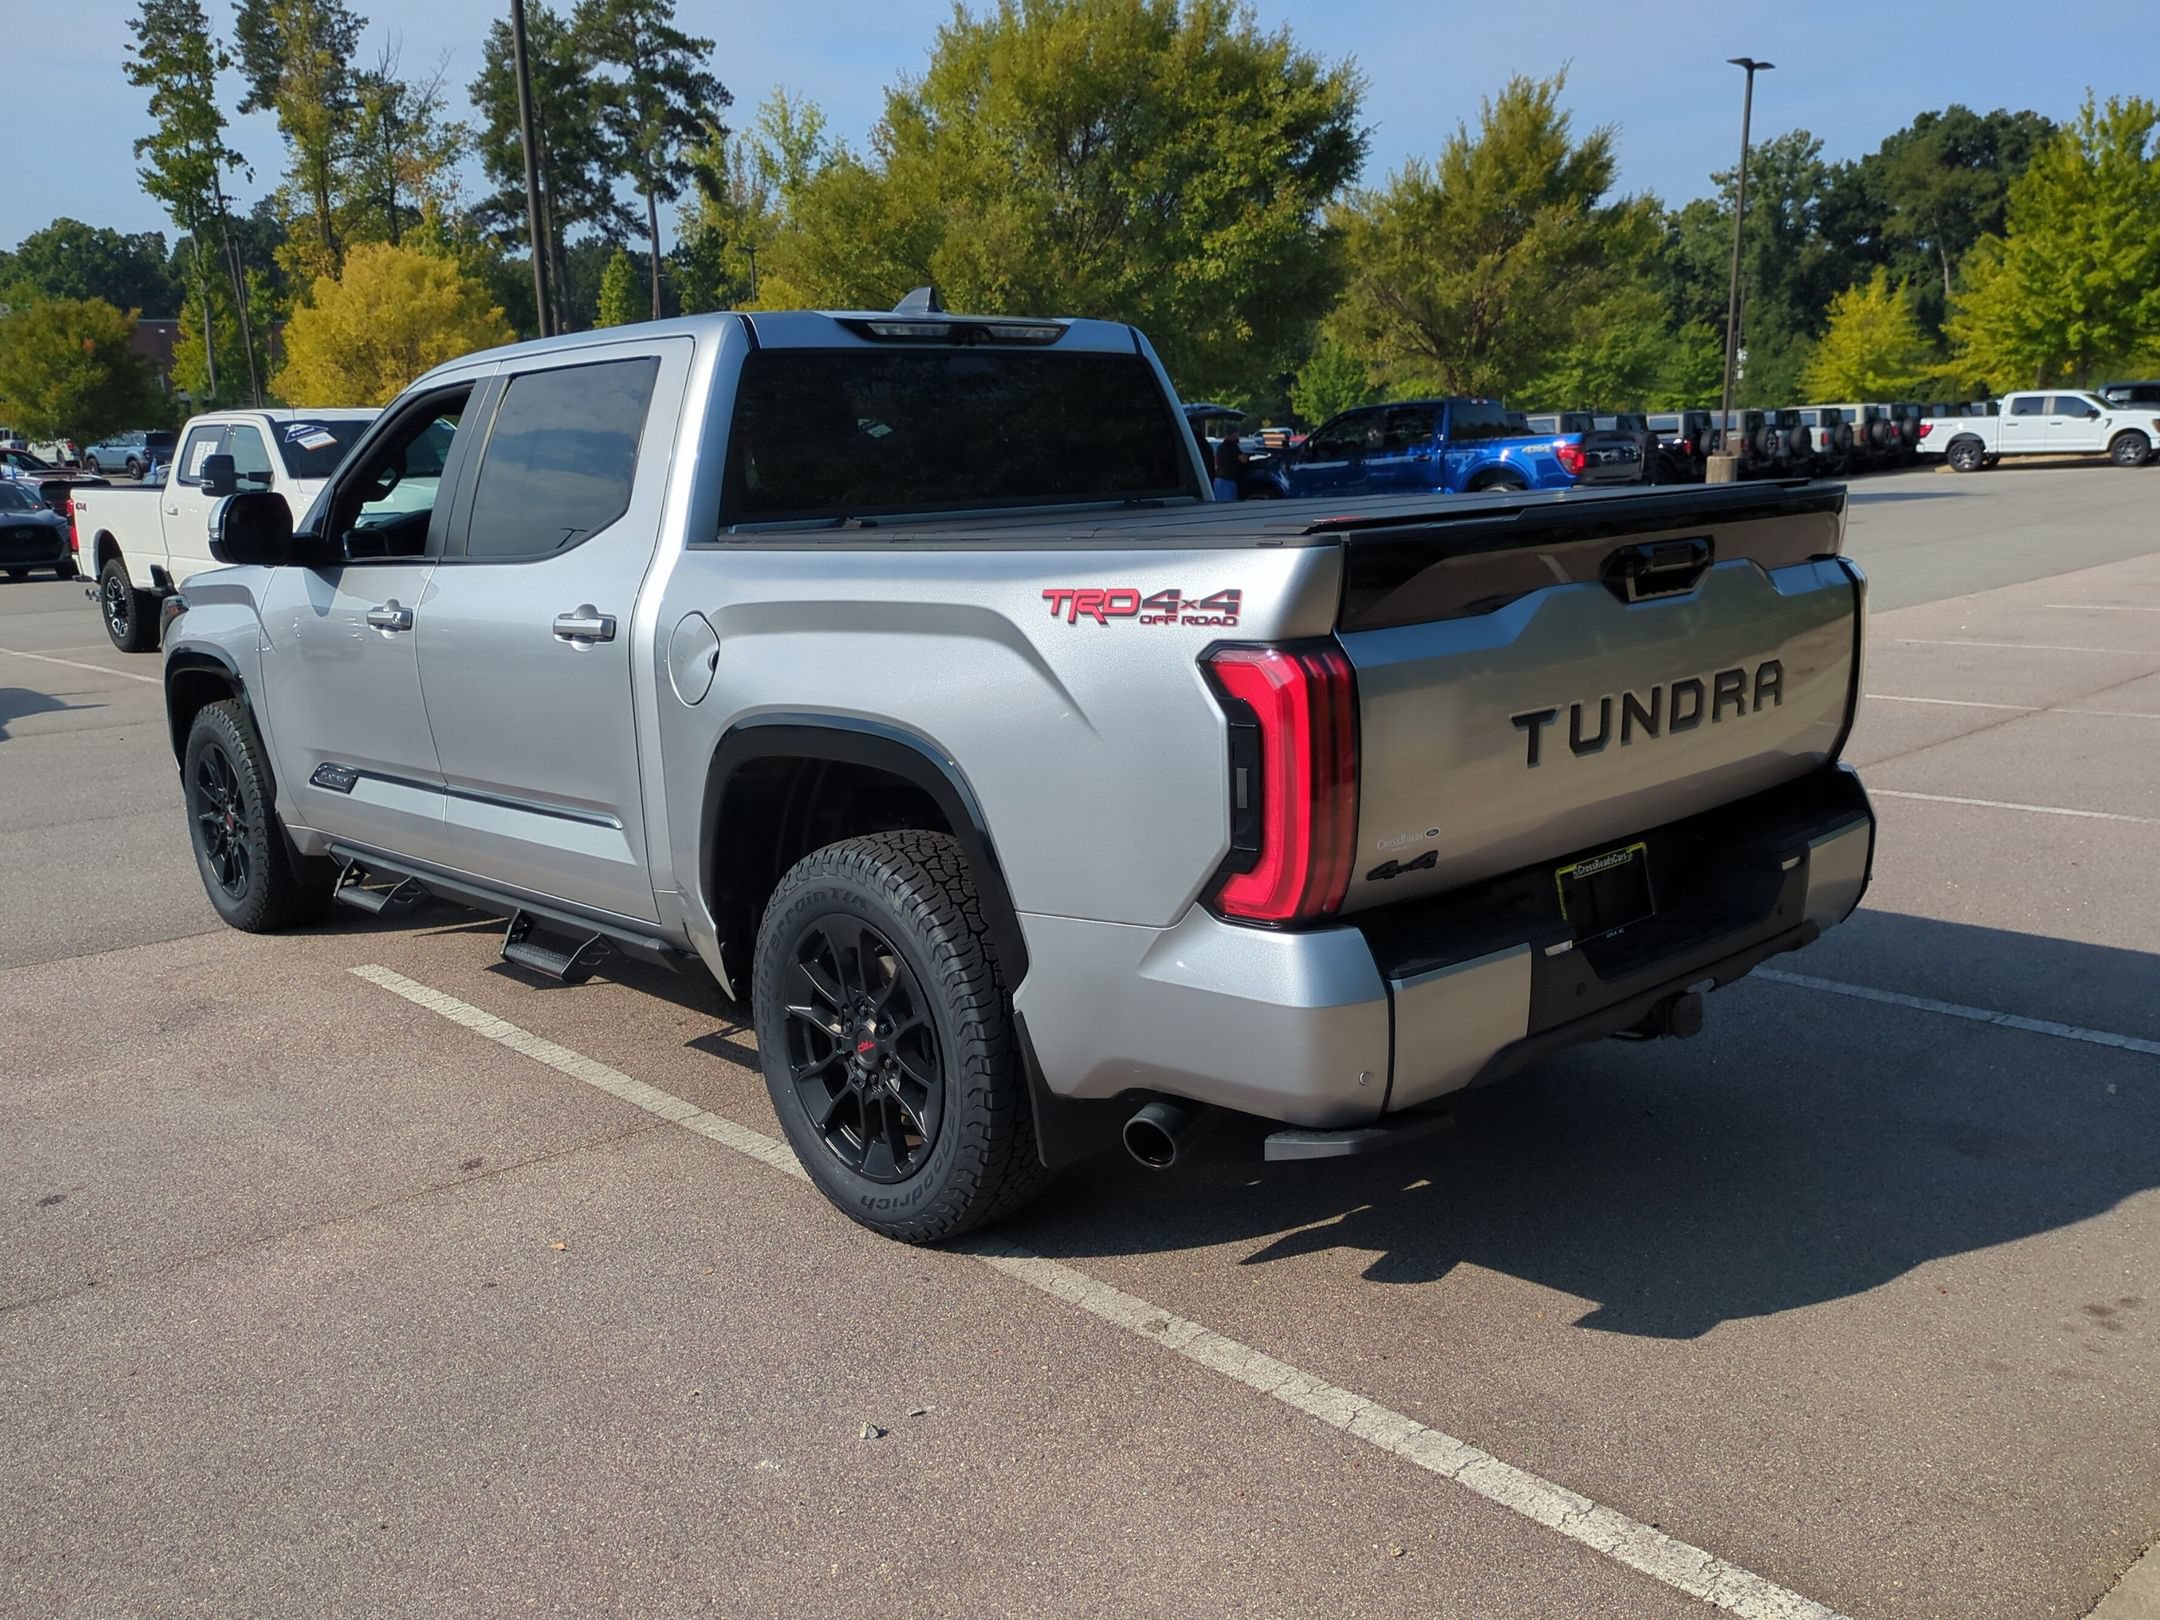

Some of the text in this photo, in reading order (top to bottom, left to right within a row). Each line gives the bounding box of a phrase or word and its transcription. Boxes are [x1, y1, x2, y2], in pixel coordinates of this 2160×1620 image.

[1042, 588, 1141, 626] TRD
[1139, 615, 1240, 627] OFF ROAD
[1509, 658, 1784, 769] TUNDRA
